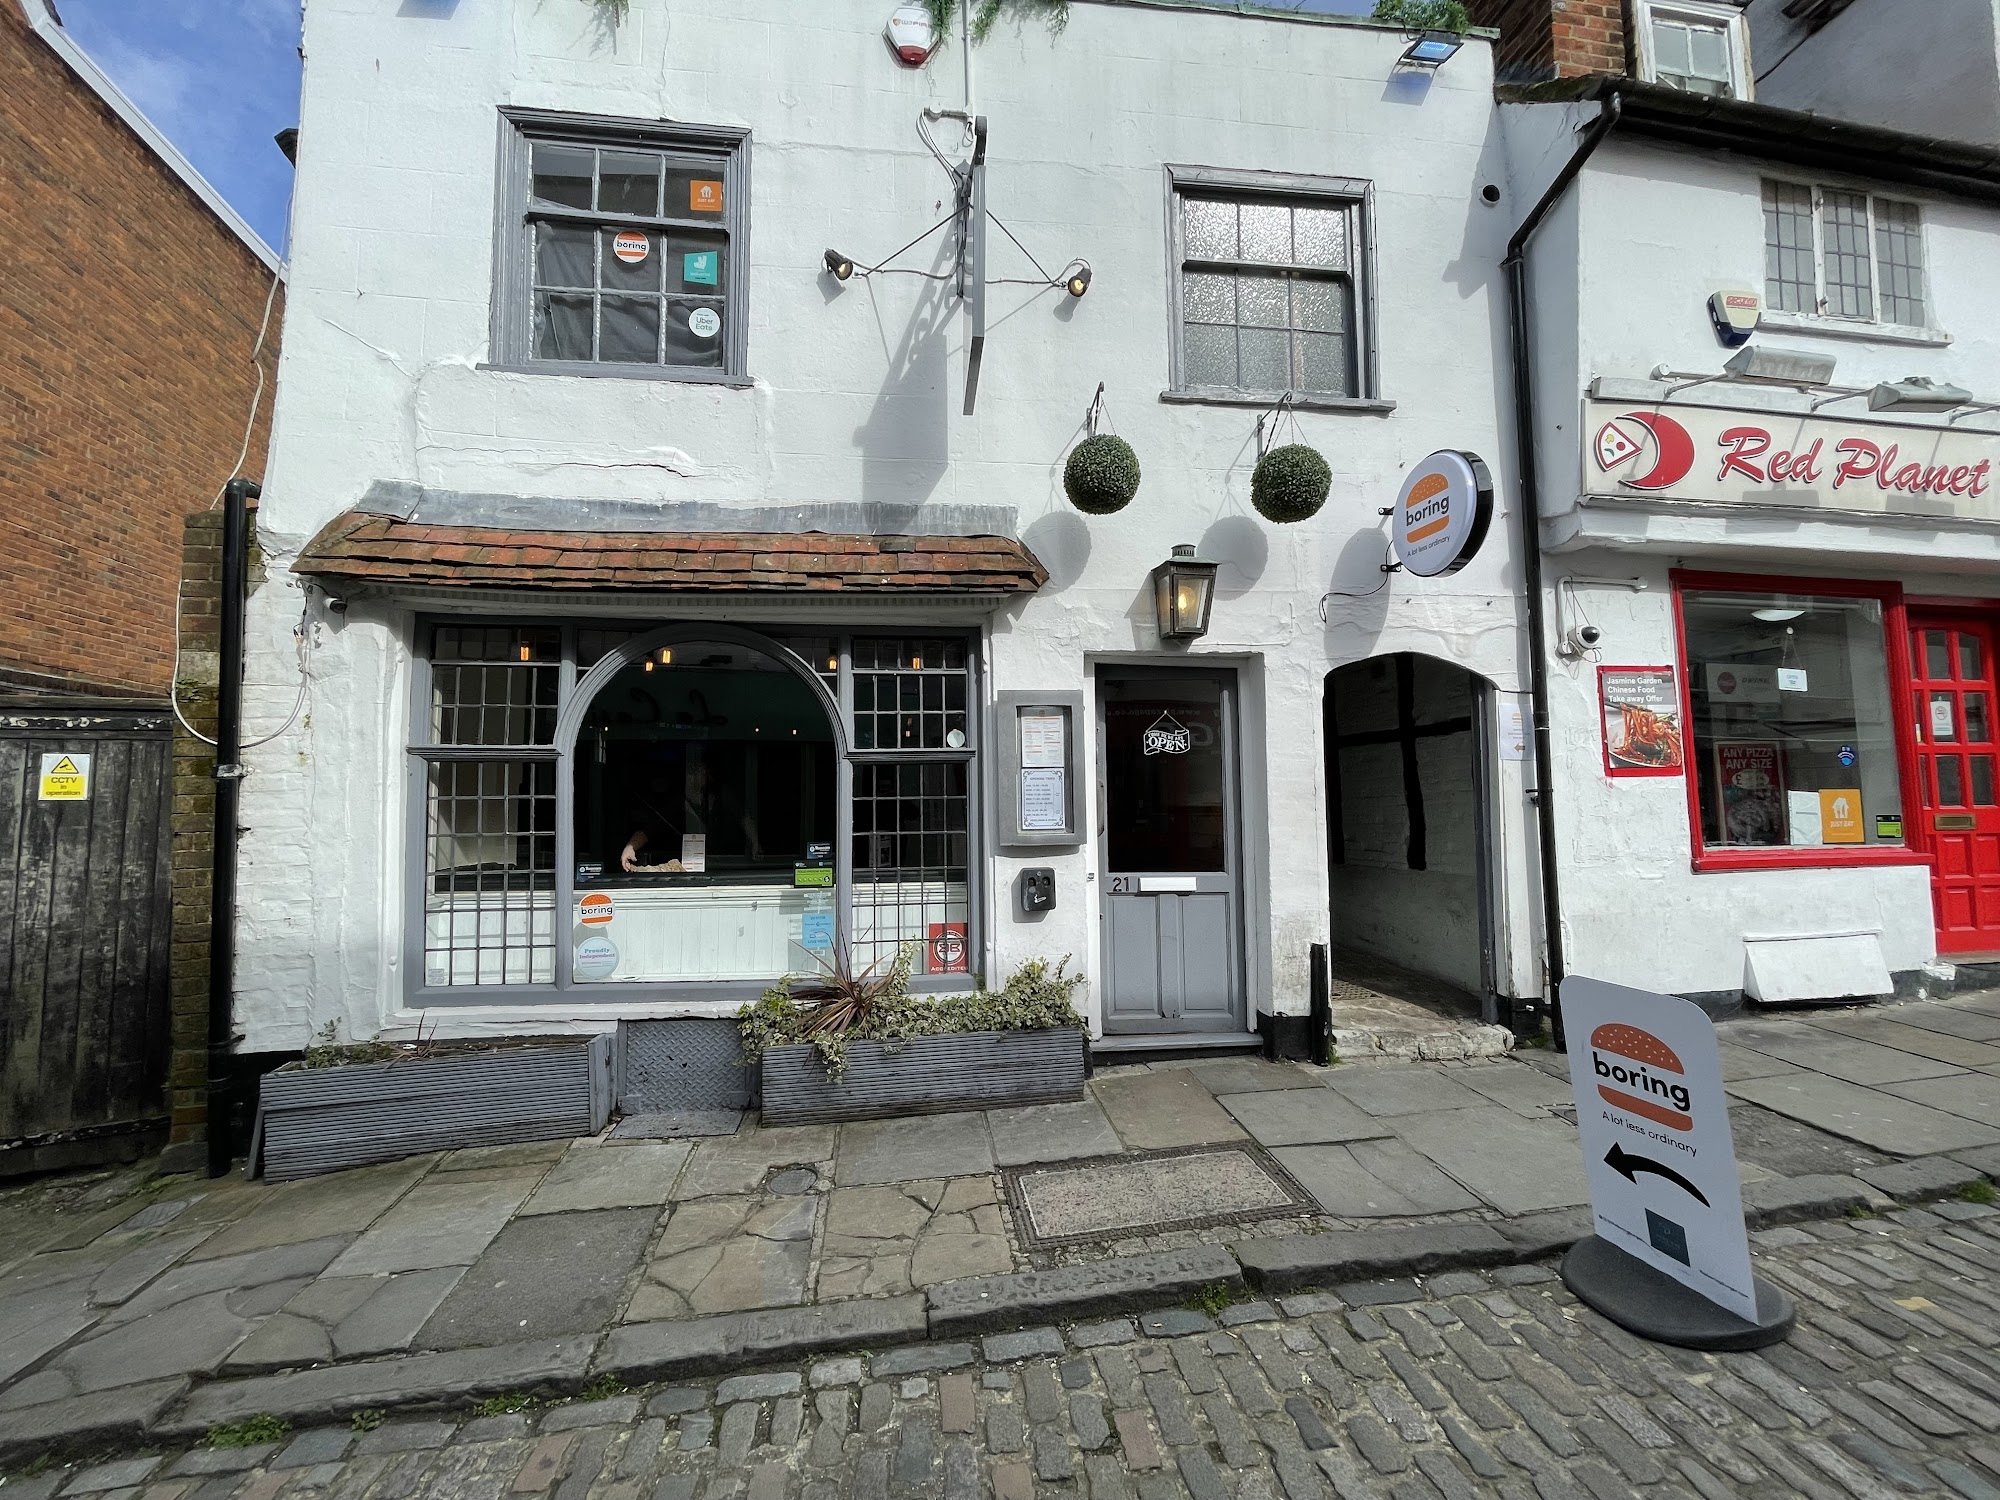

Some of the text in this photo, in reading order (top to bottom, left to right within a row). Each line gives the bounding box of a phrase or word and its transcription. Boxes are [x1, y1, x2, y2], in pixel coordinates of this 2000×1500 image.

[616, 240, 647, 251] boring
[695, 324, 713, 332] Eats
[696, 316, 713, 325] Uber
[1718, 426, 1991, 498] Red Planet
[1406, 496, 1450, 526] boring
[1418, 544, 1428, 554] less
[1428, 535, 1451, 549] ordinary
[1148, 736, 1185, 751] OPEN
[1723, 747, 1774, 758] ANY PIZZA
[1725, 759, 1773, 769] ANY SIZE
[1112, 876, 1130, 892] 21
[581, 905, 613, 915] boring
[1592, 1050, 1691, 1112] boring
[1602, 1111, 1697, 1158] A lot less ordinary
